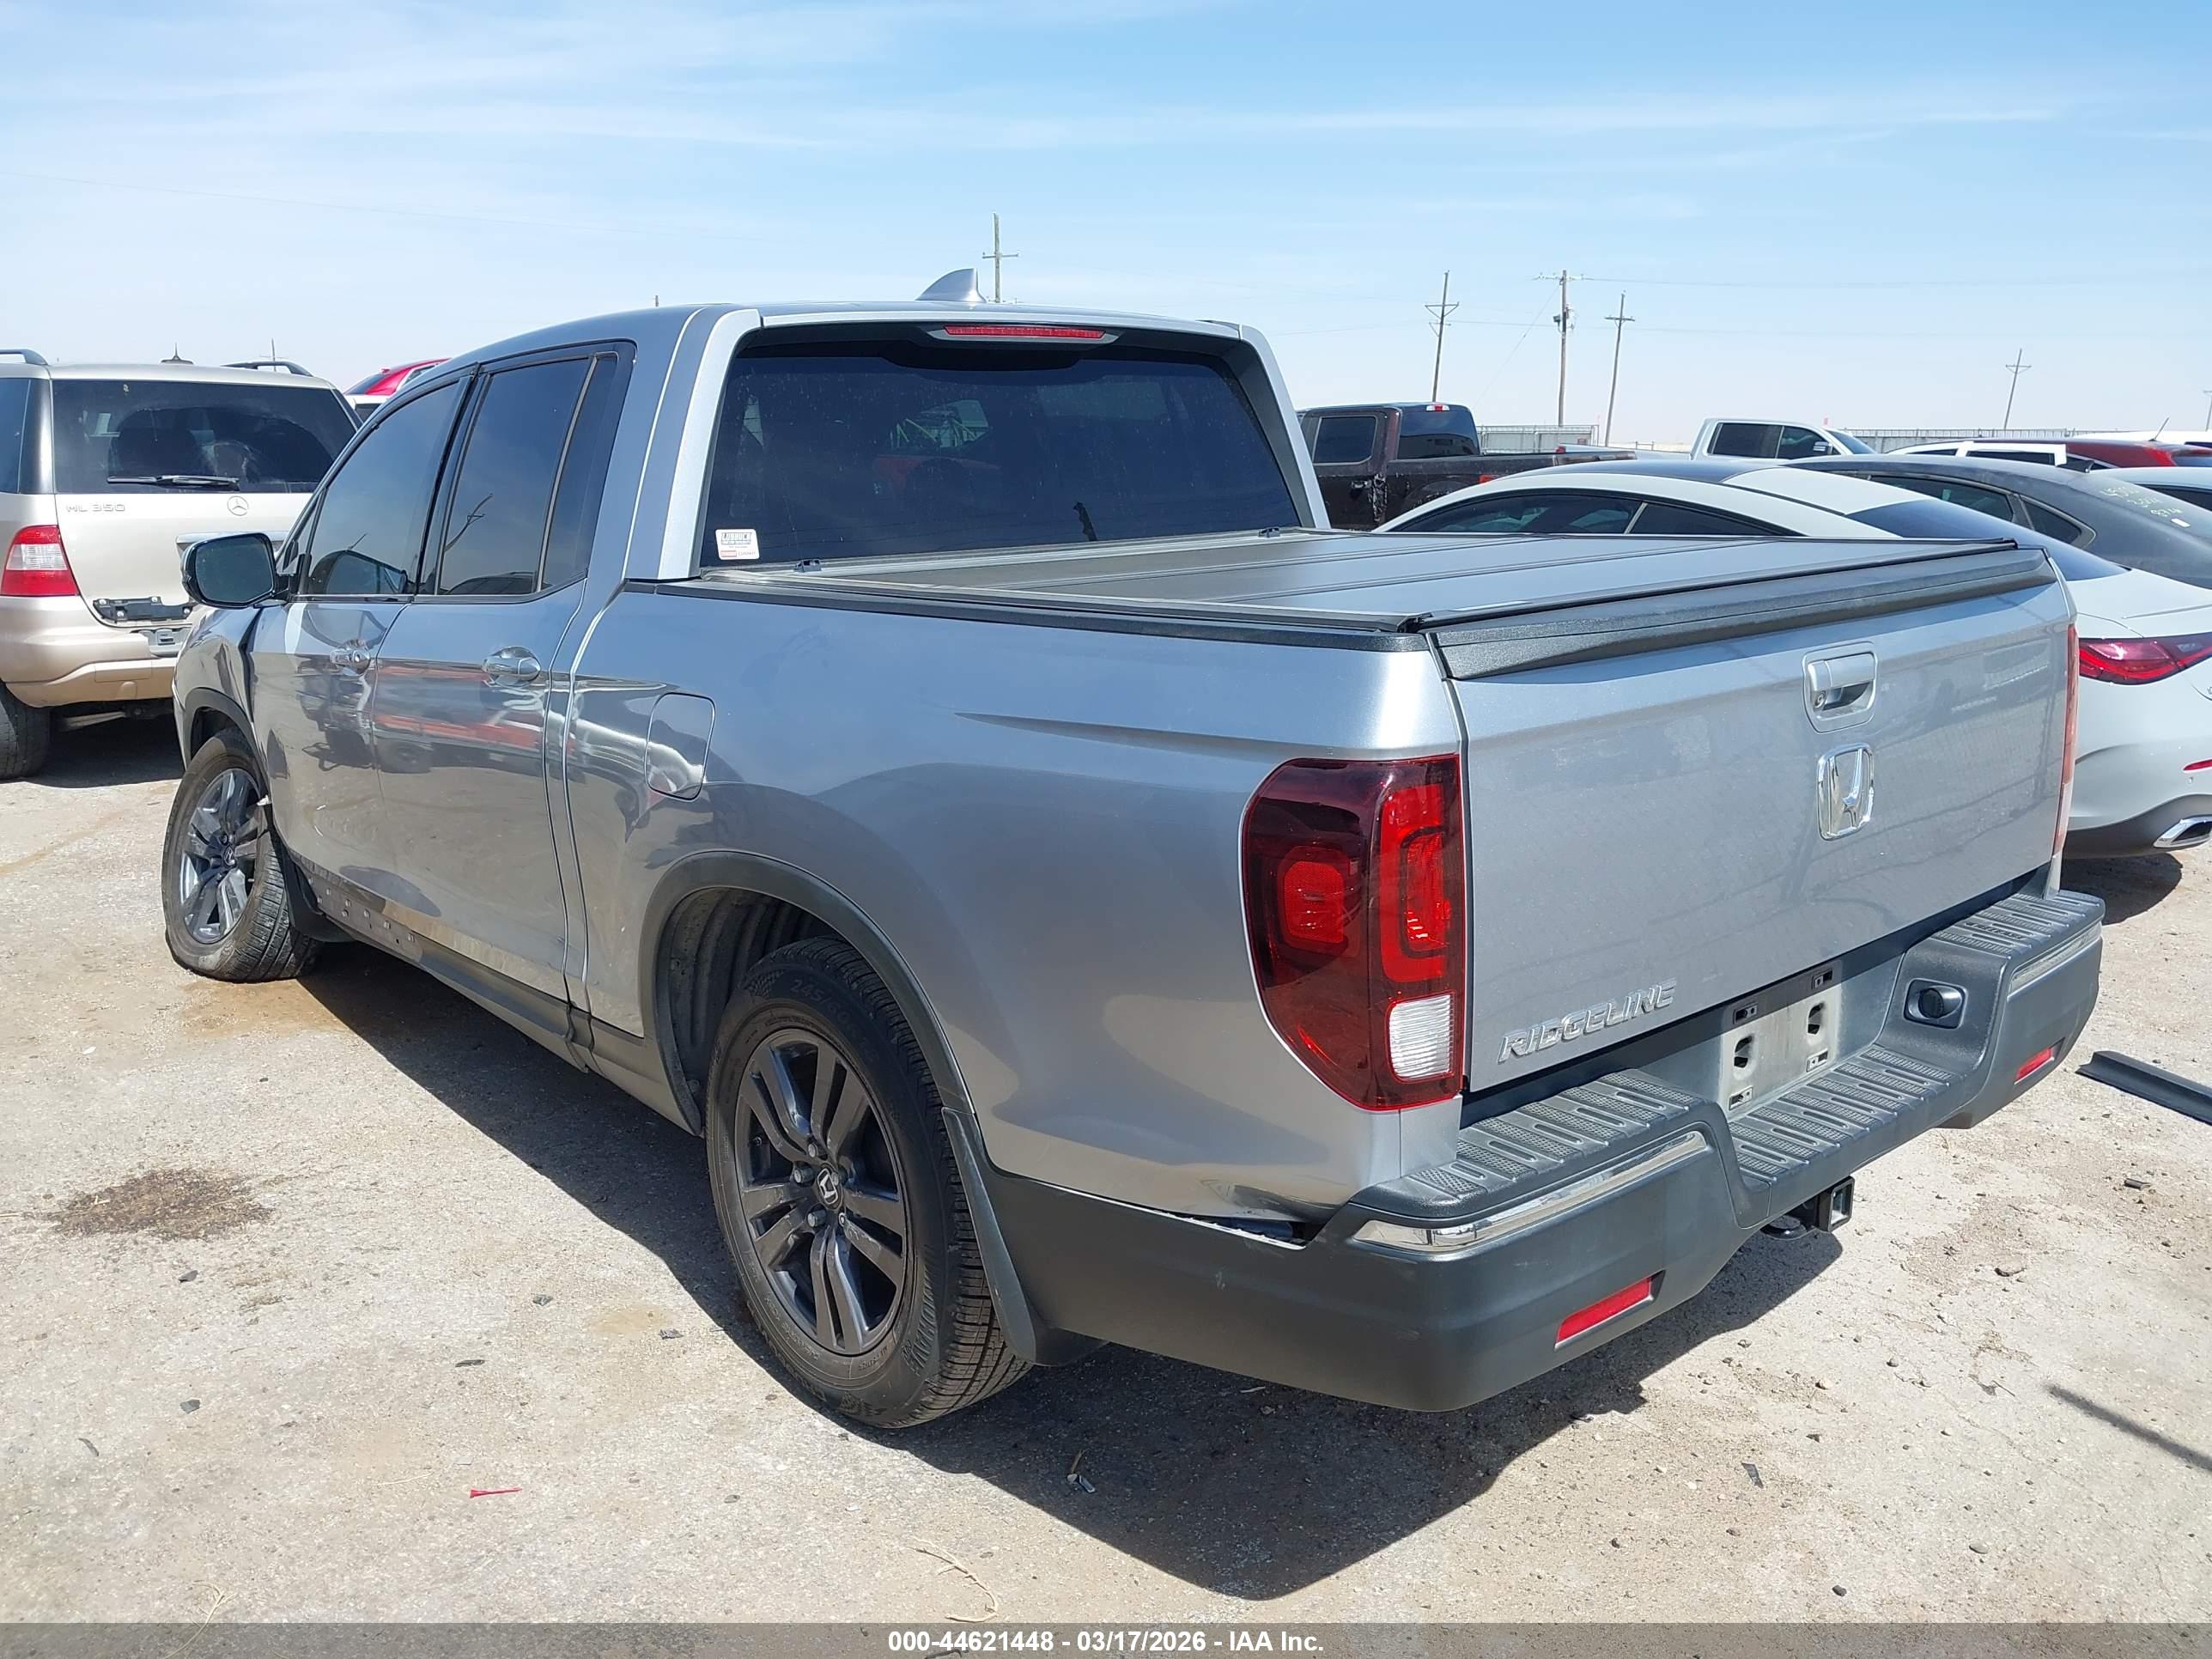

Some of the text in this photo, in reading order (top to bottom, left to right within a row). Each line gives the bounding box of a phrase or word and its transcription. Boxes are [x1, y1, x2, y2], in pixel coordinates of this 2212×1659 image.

[66, 503, 126, 513] ML 350
[1498, 977, 1676, 1064] RIDGELINE
